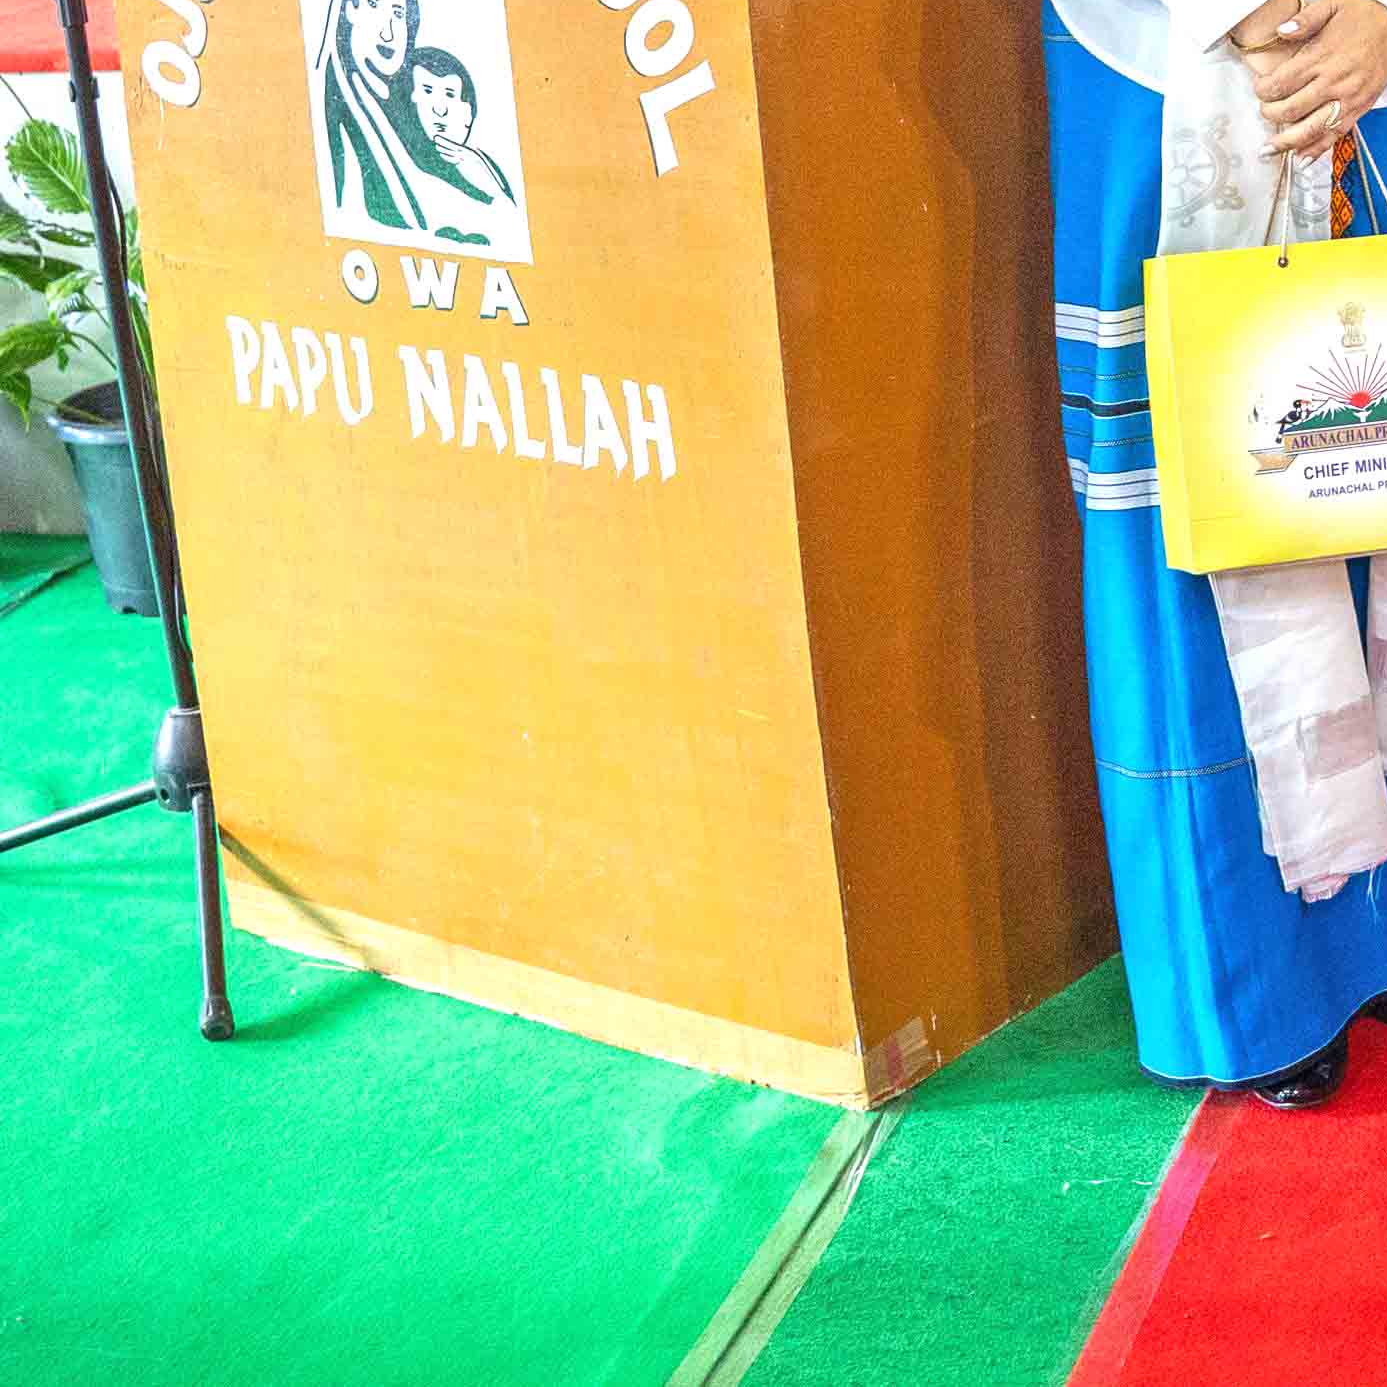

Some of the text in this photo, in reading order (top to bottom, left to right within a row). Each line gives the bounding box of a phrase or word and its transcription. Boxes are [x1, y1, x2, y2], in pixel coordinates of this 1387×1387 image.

[225, 315, 678, 483] PAPU NALLAH
[1291, 427, 1373, 450] ARUNACHAL
[1303, 462, 1350, 480] CHIEF
[1308, 482, 1376, 499] ARUNACHAL
